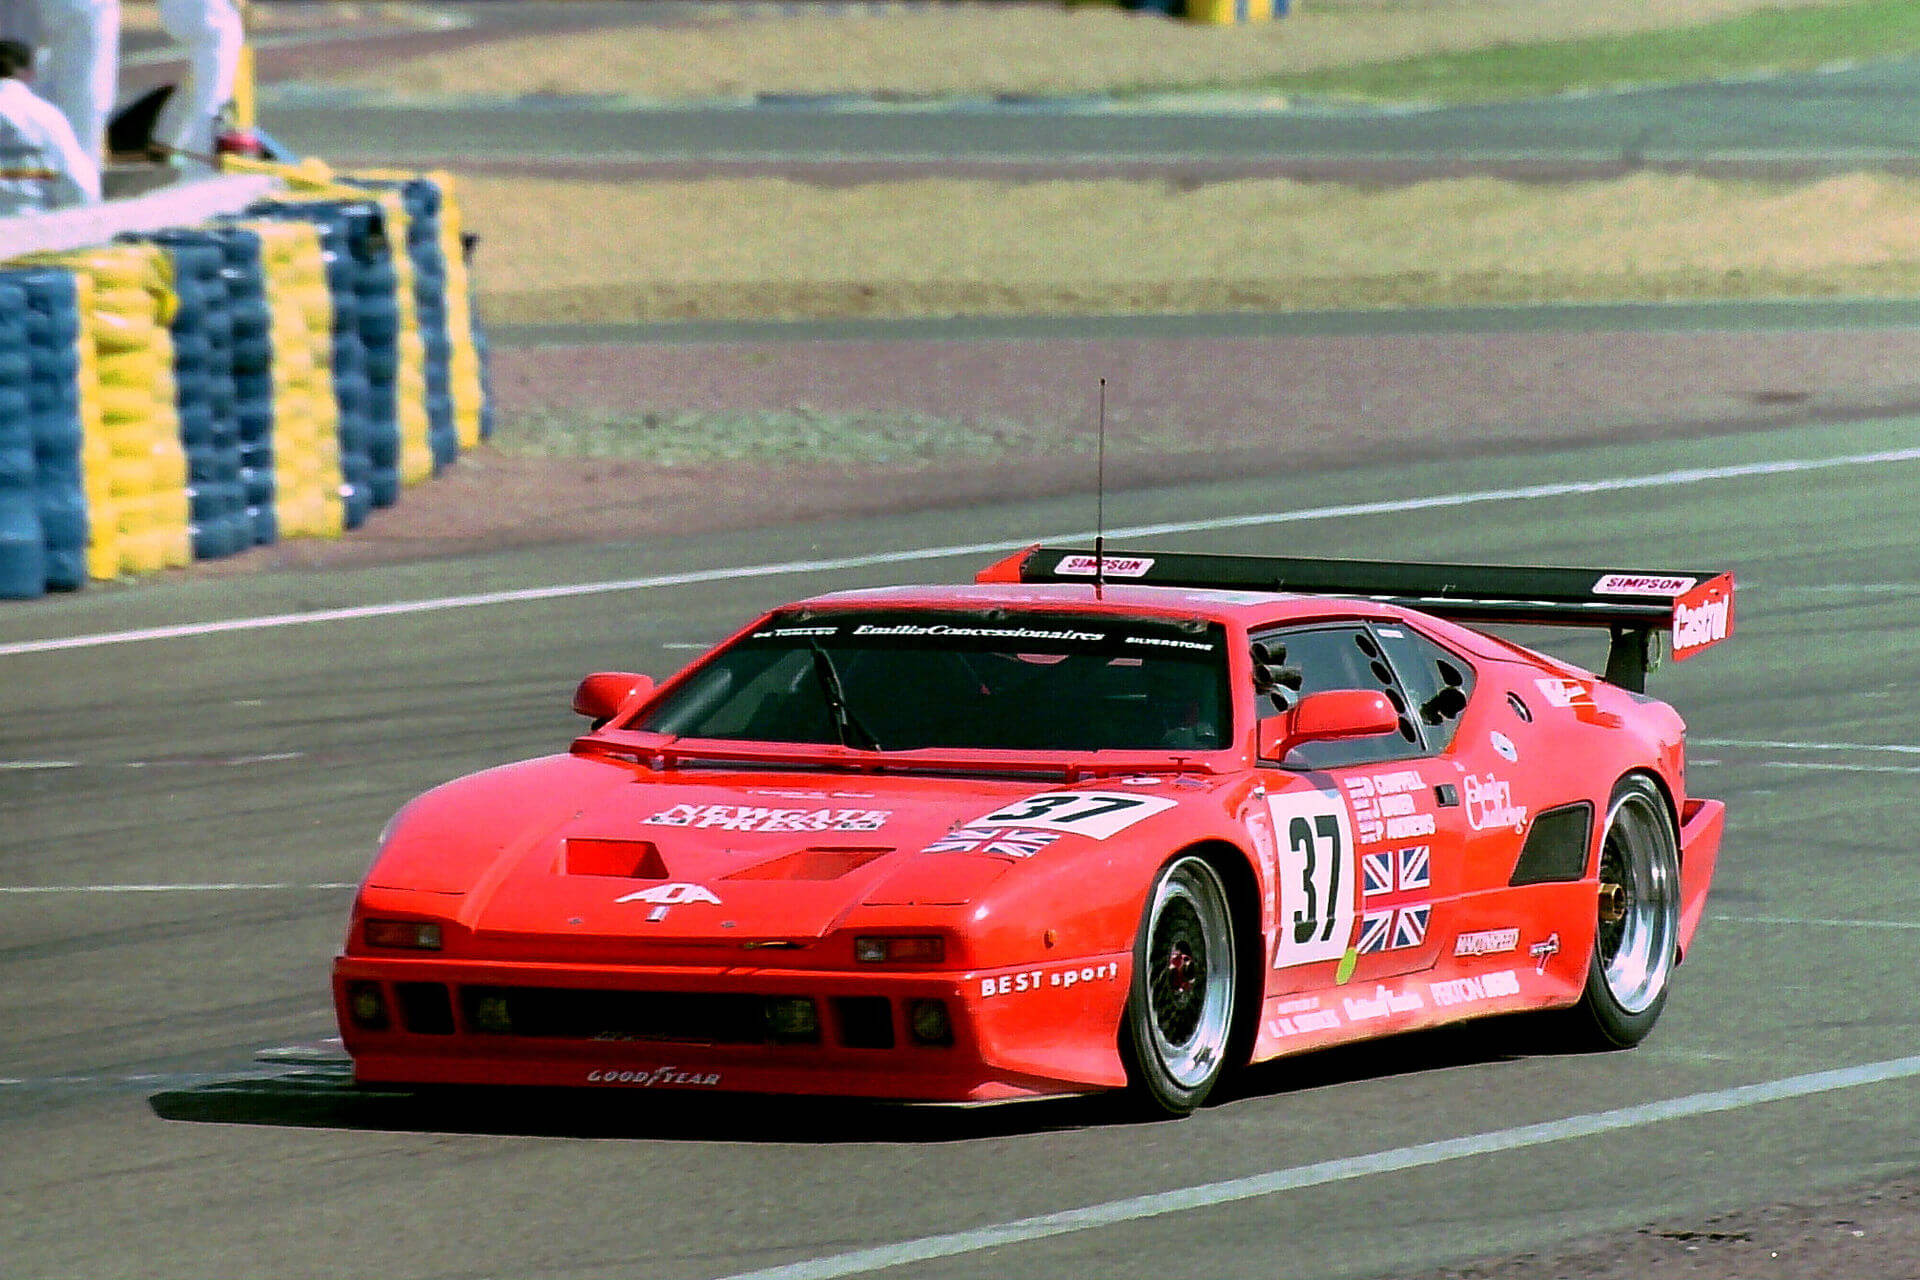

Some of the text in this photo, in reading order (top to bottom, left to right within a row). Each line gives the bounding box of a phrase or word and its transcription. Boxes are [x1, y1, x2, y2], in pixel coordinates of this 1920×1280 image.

[1068, 557, 1143, 571] SIMPSON
[1606, 577, 1685, 590] SIMPSON
[1672, 594, 1730, 650] Castrol
[1125, 636, 1214, 651] SILVERSTONE
[655, 803, 894, 821] NEWGATE
[986, 796, 1146, 823] 37
[693, 817, 830, 832] PRESS
[1289, 814, 1341, 944] 37
[981, 961, 1118, 998] BEST sport
[587, 1066, 721, 1086] GOODYEAR
